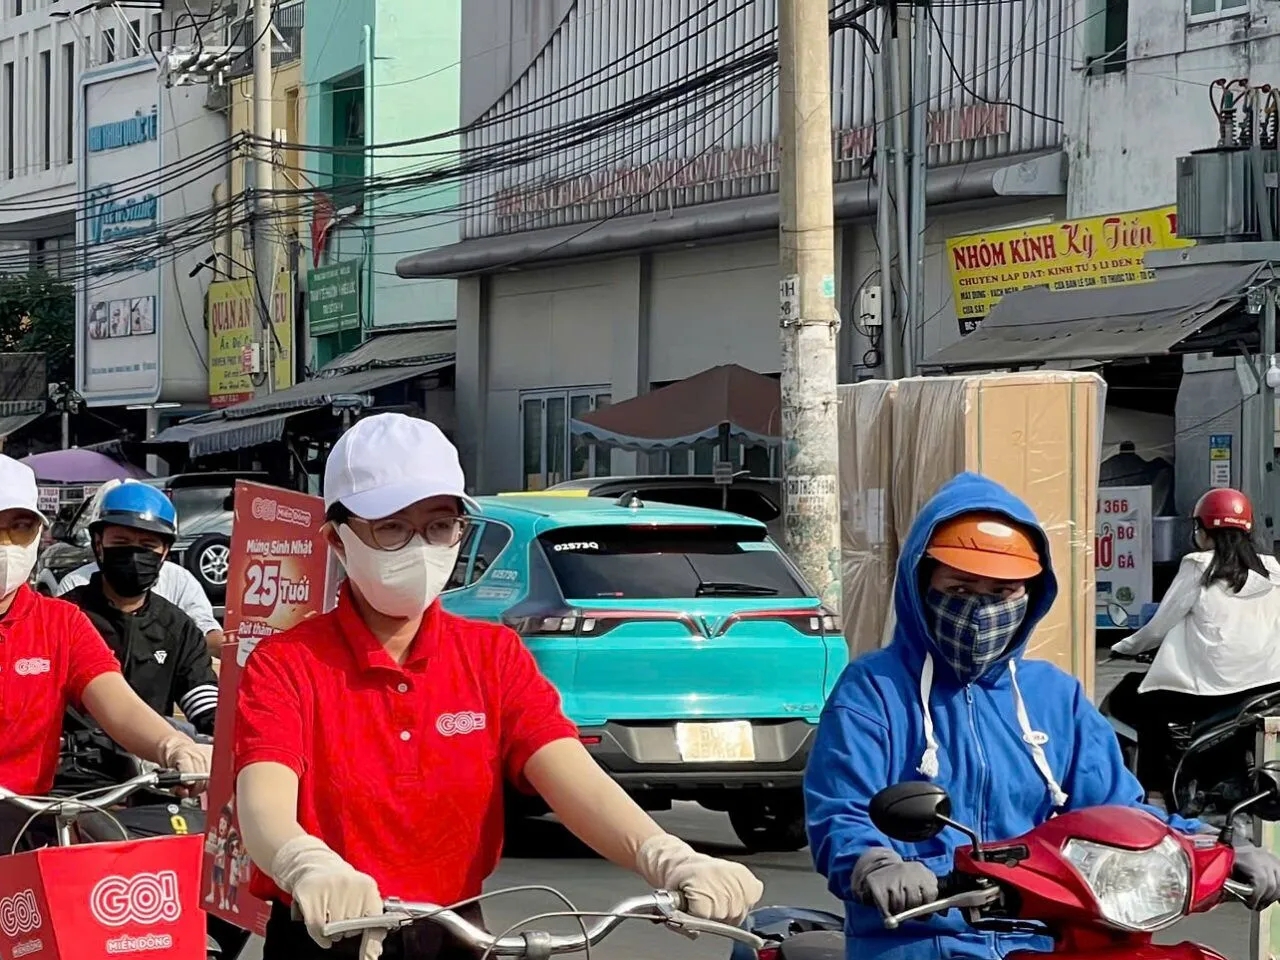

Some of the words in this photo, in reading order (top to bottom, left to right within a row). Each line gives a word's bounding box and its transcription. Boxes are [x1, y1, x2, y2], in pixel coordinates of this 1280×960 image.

[952, 238, 1006, 270] NHÔM
[1009, 231, 1056, 264] KÍNH
[1104, 499, 1128, 513] 366
[247, 539, 270, 556] Mừng
[270, 540, 290, 554] Sinh
[291, 539, 313, 558] Nhật
[1117, 550, 1135, 569] GÀ
[243, 563, 279, 606] 25
[280, 574, 310, 602] Tuổi
[91, 870, 181, 927] GO!
